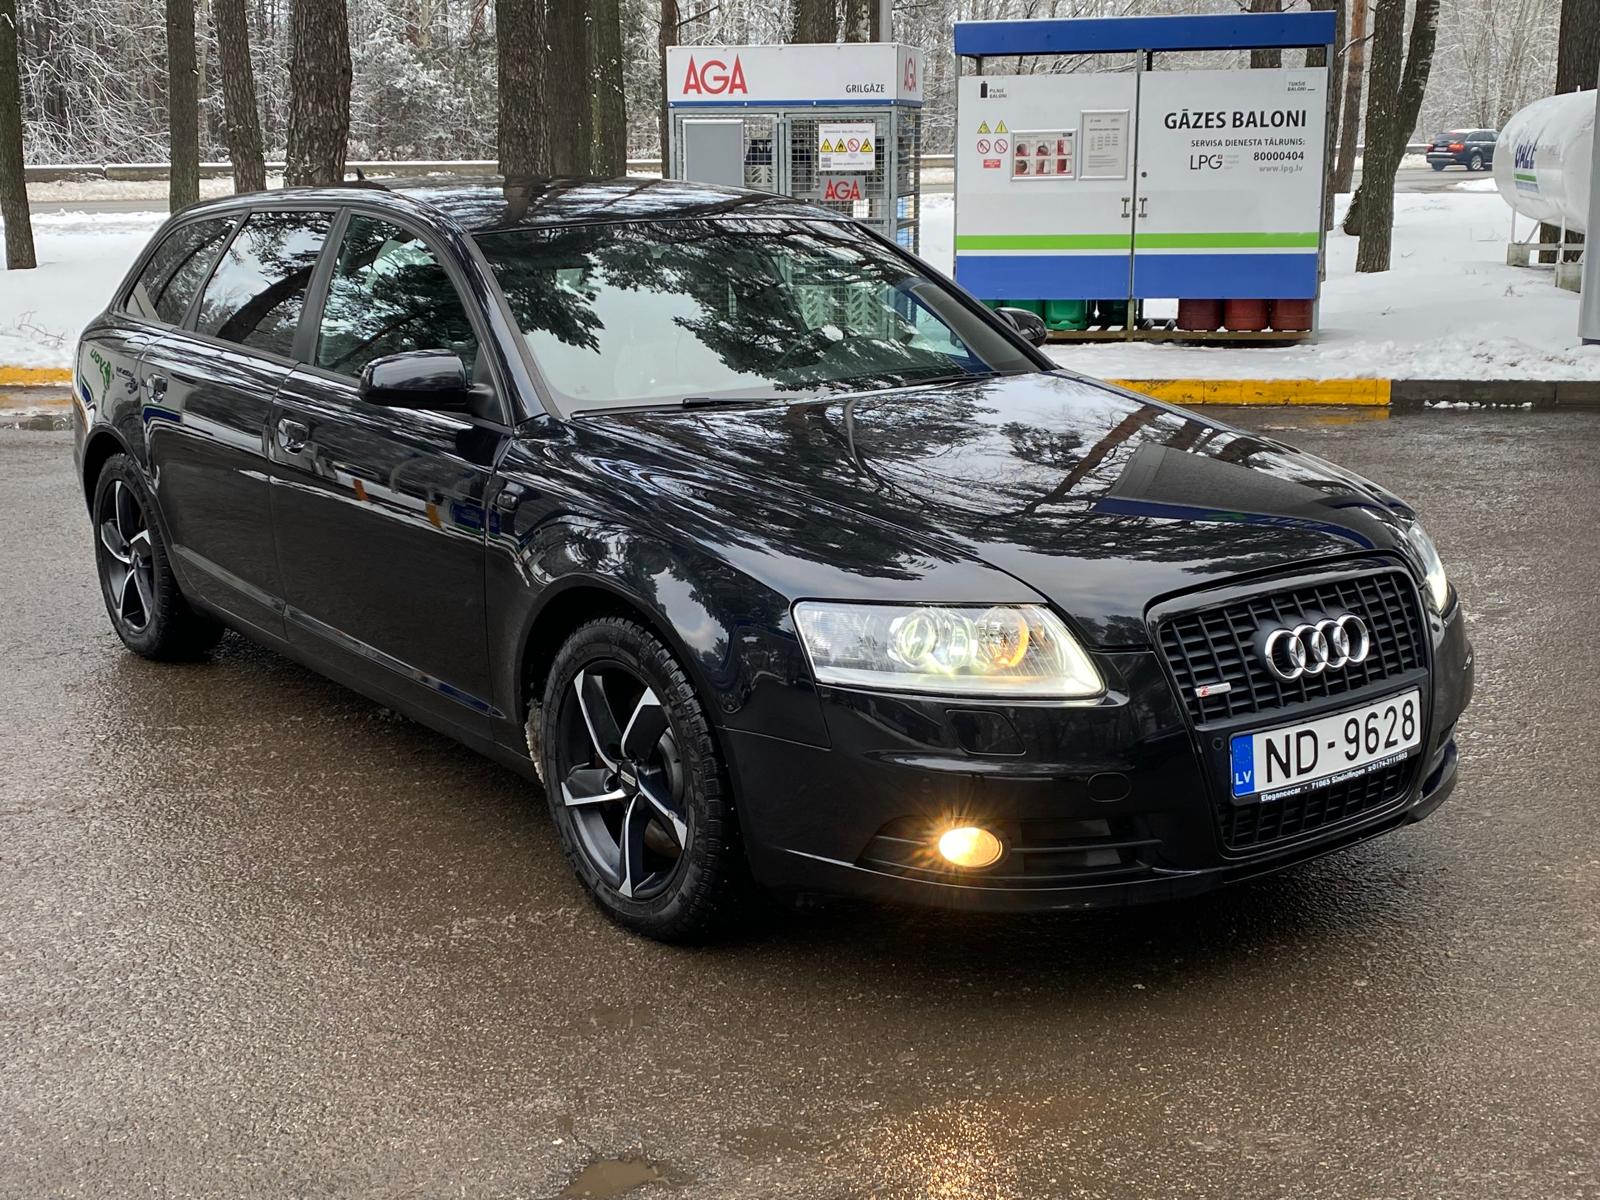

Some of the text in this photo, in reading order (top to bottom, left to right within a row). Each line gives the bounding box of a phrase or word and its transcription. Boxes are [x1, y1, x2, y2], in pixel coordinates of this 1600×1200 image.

[682, 53, 748, 95] AGA
[903, 56, 917, 92] AGA
[845, 83, 886, 94] GRILGĀZE
[1164, 108, 1307, 130] GĀZES BALONI
[1191, 136, 1306, 148] SERVISA DIENESTA TĀLRUNIS:
[1190, 154, 1223, 170] LPG
[1253, 151, 1305, 161] 80000404
[1259, 163, 1304, 174] www.lpg.lv
[825, 179, 861, 201] AGA
[1264, 699, 1416, 784] ND-9628
[1234, 769, 1252, 786] LV
[1261, 786, 1301, 802] Elegancecar
